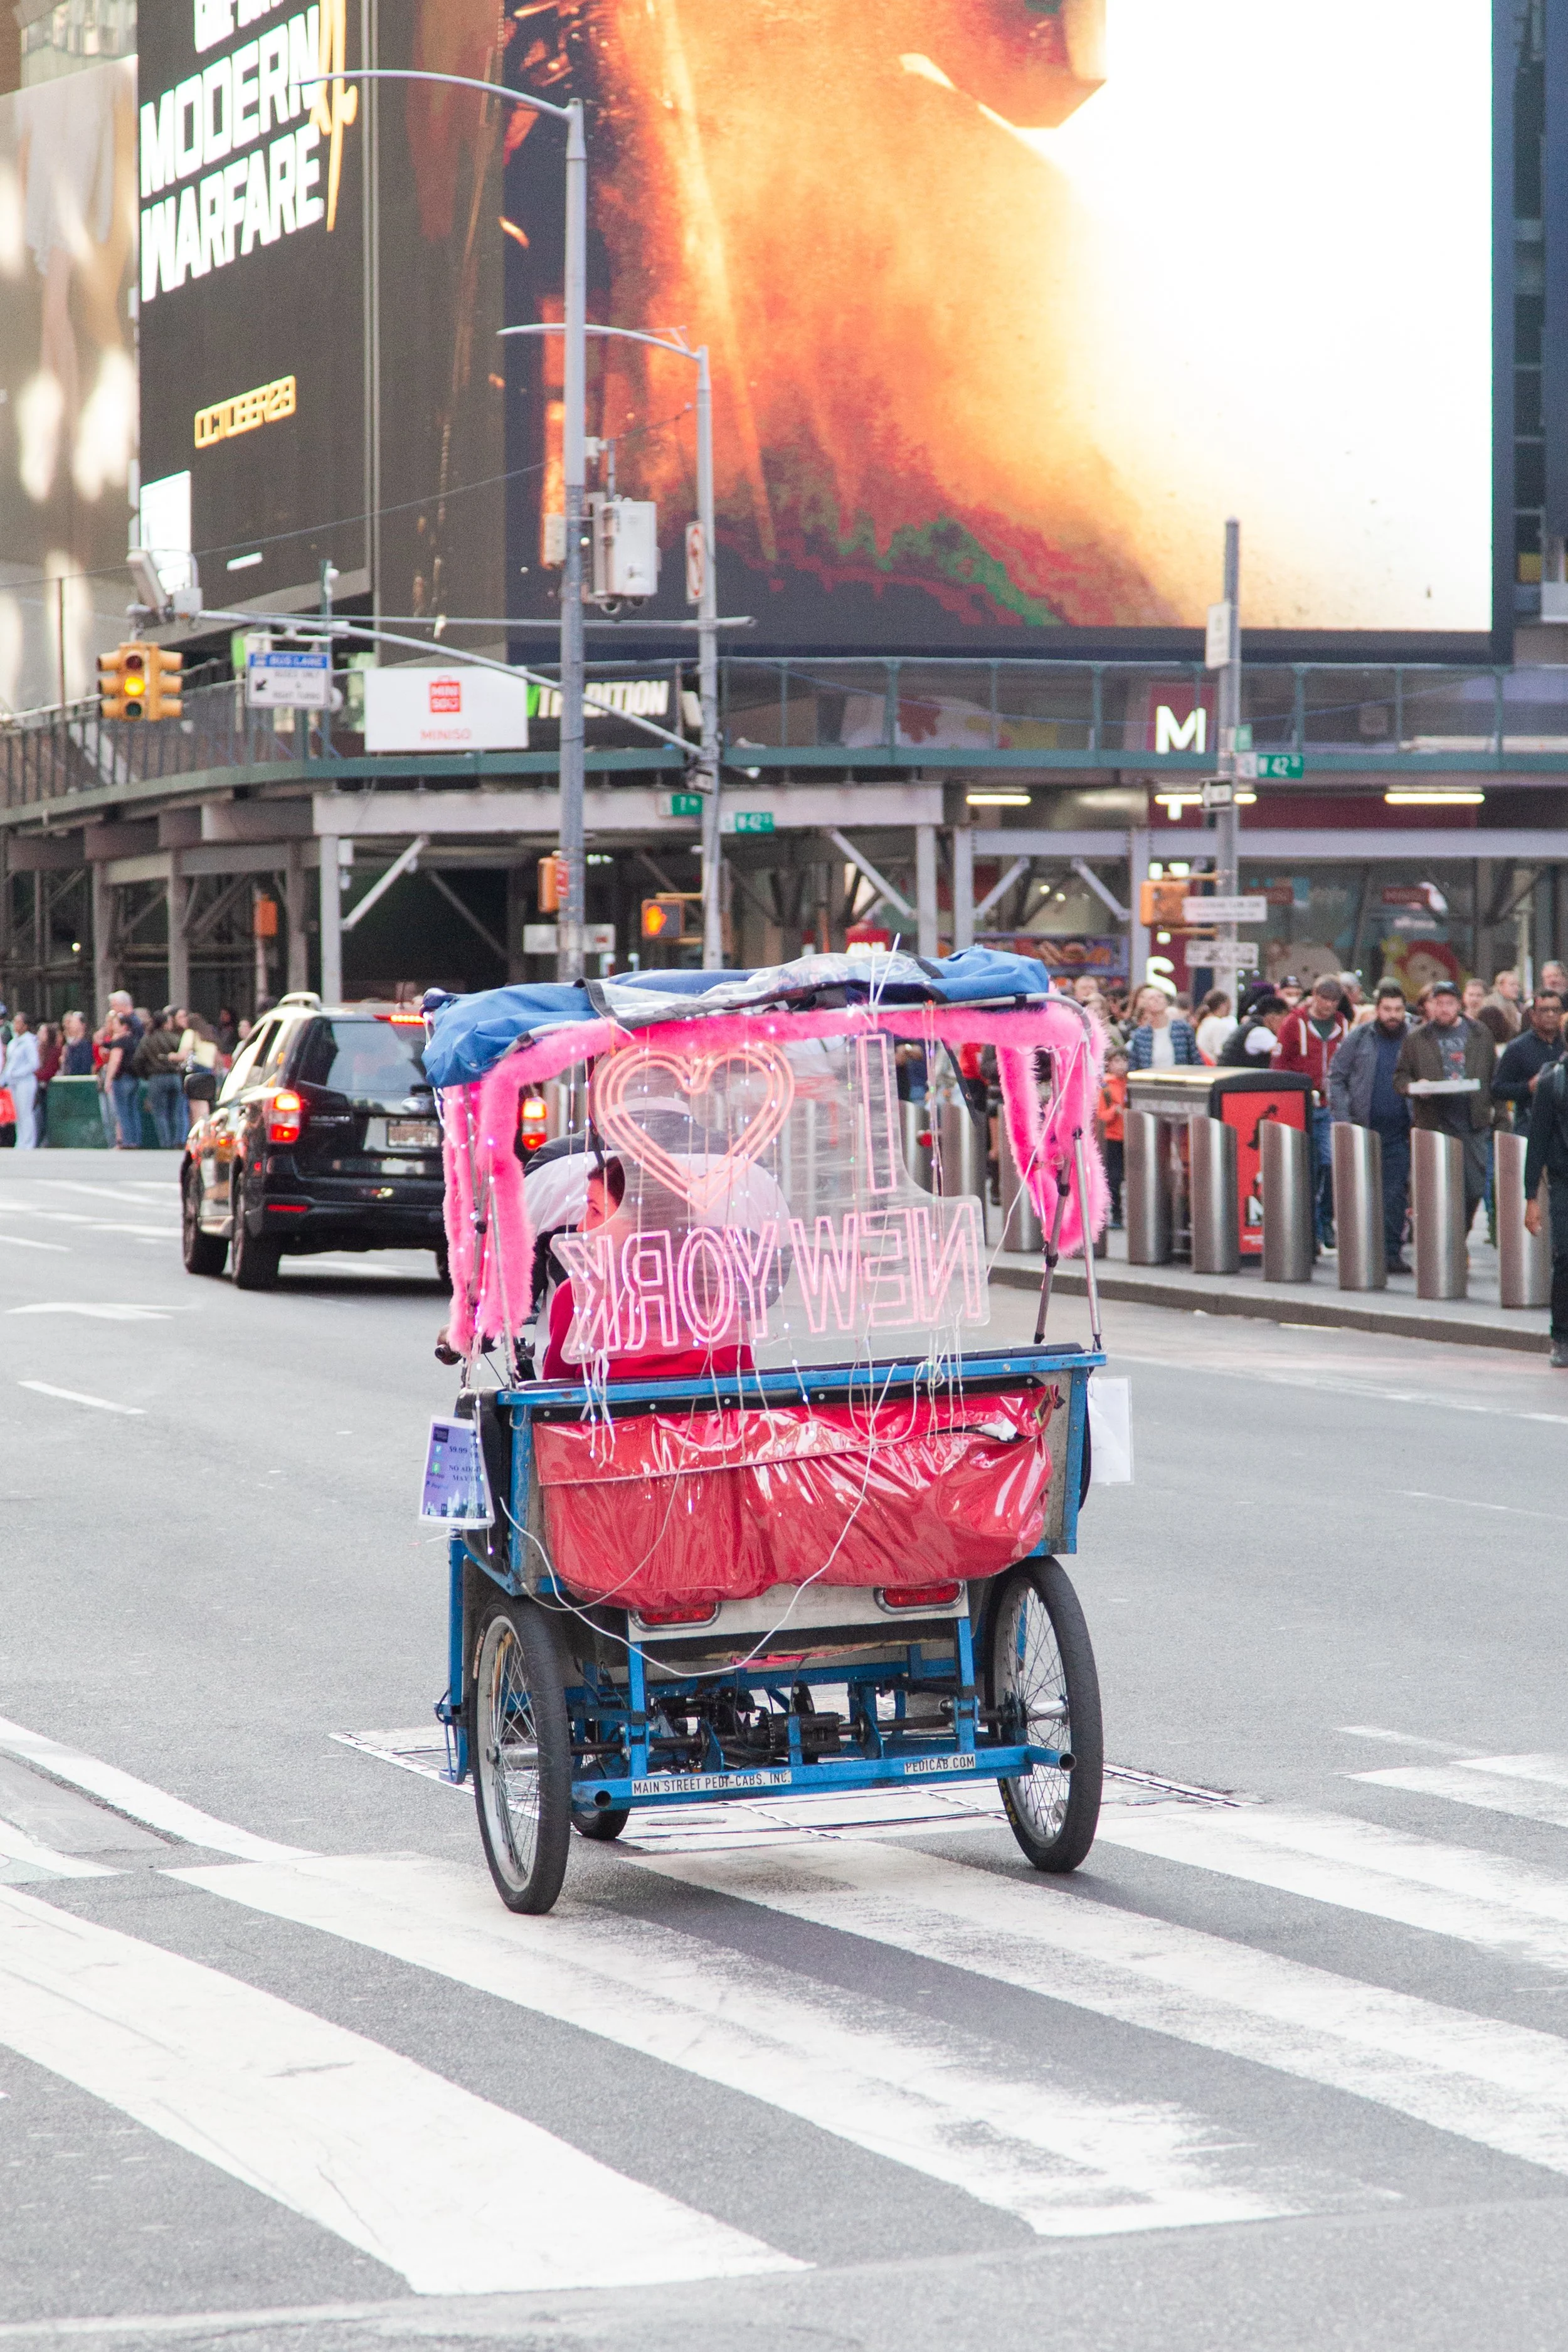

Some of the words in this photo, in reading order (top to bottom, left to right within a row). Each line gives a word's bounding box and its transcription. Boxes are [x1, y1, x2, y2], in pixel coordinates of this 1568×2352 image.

[140, 4, 320, 198] MODERN
[140, 122, 324, 302] WARFARE
[539, 680, 669, 718] TRDITION
[421, 728, 472, 740] MINISO
[449, 1445, 467, 1454] $9.99
[905, 1756, 975, 1772] PEDICAB.COM
[633, 1781, 660, 1794] MAIN
[664, 1778, 701, 1792] STREET
